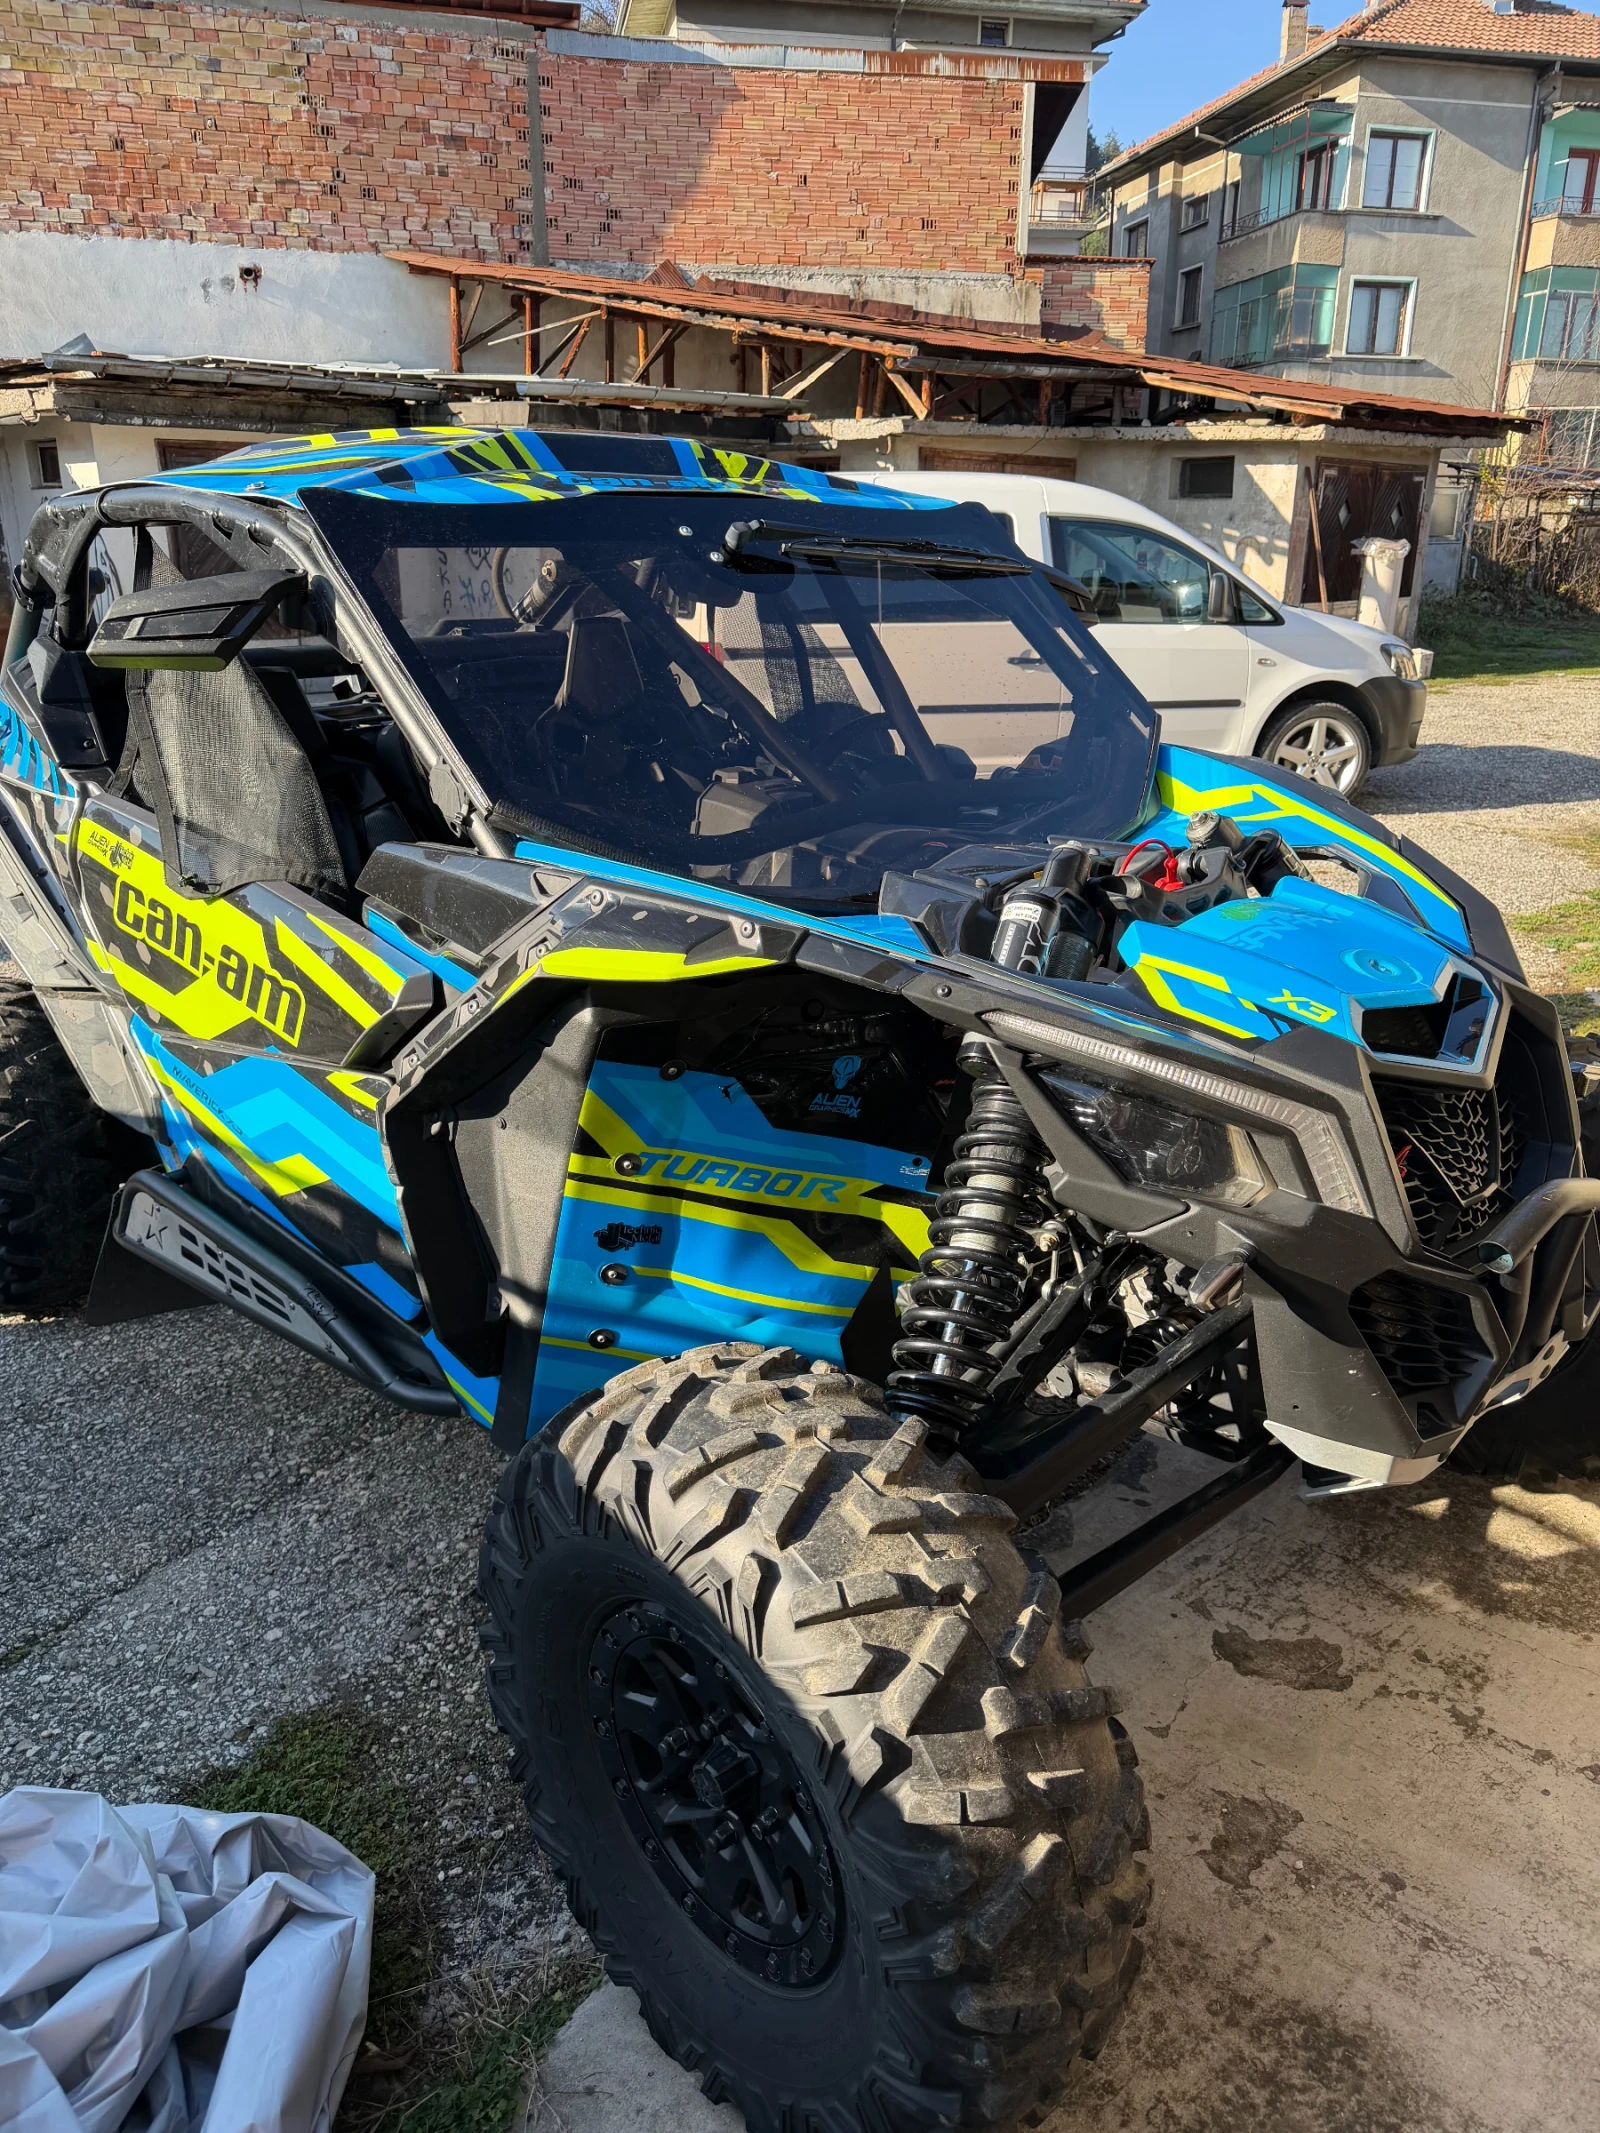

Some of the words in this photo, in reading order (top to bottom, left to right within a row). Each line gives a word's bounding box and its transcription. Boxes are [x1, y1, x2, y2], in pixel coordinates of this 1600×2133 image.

[115, 878, 303, 1041] can-am
[1266, 988, 1338, 1023] X3
[811, 1092, 862, 1108] ALIEN
